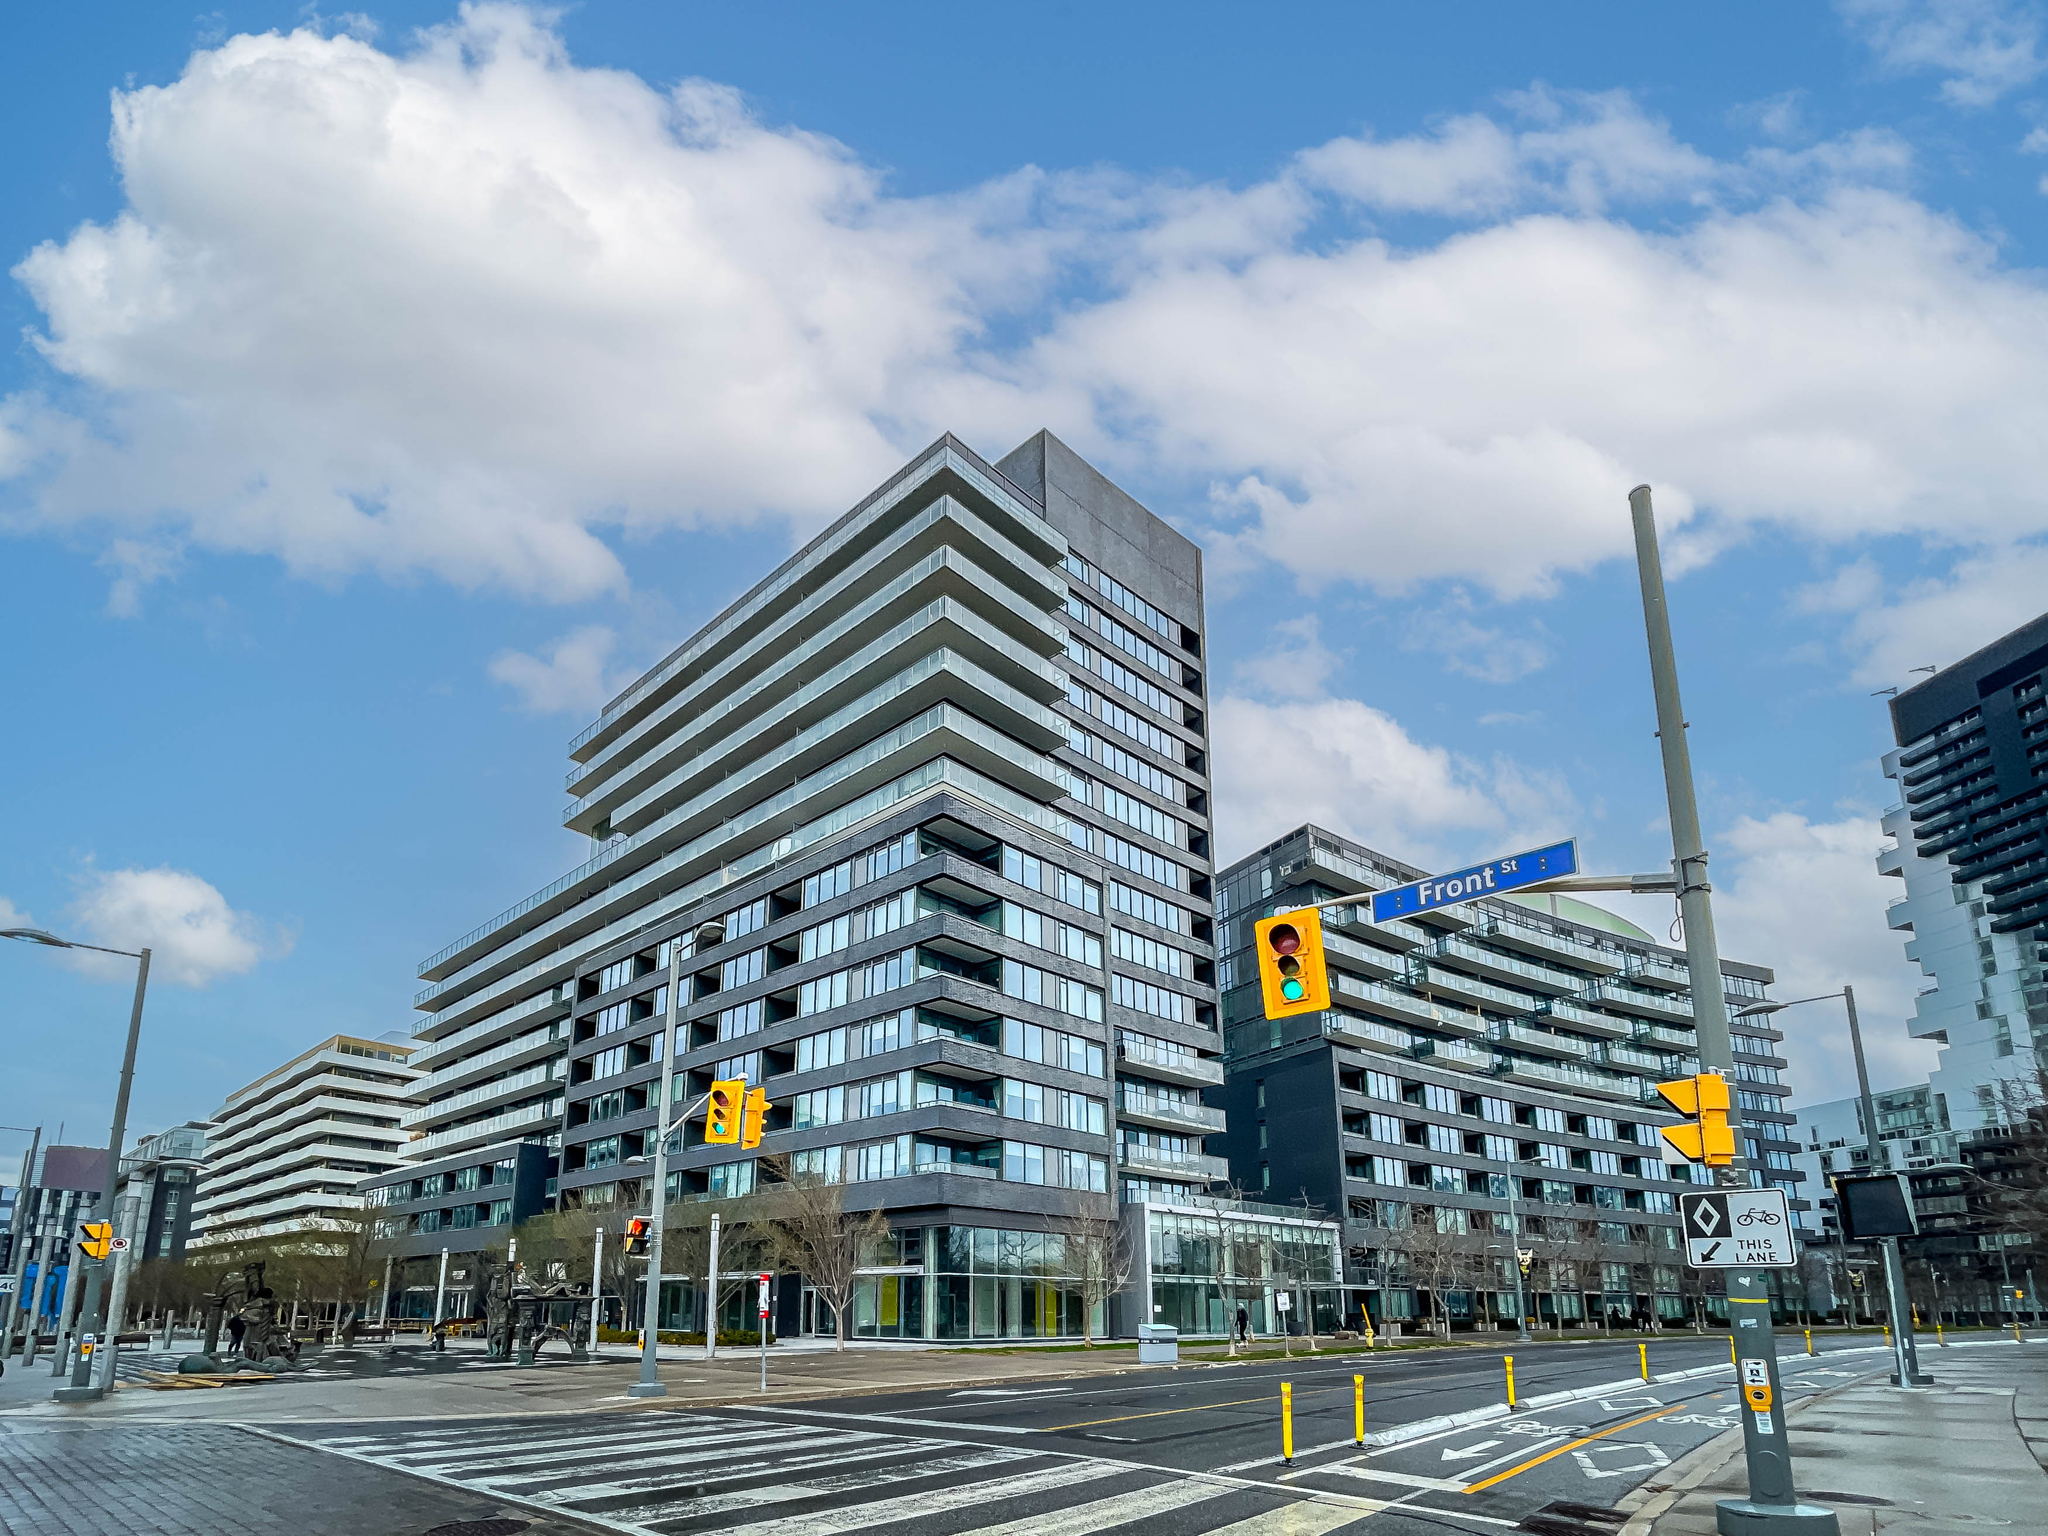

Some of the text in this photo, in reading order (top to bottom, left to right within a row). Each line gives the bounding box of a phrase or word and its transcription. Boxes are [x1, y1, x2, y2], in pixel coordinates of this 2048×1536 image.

[1419, 859, 1518, 905] Front St
[1737, 1239, 1772, 1250] THIS
[1735, 1251, 1778, 1262] LANE
